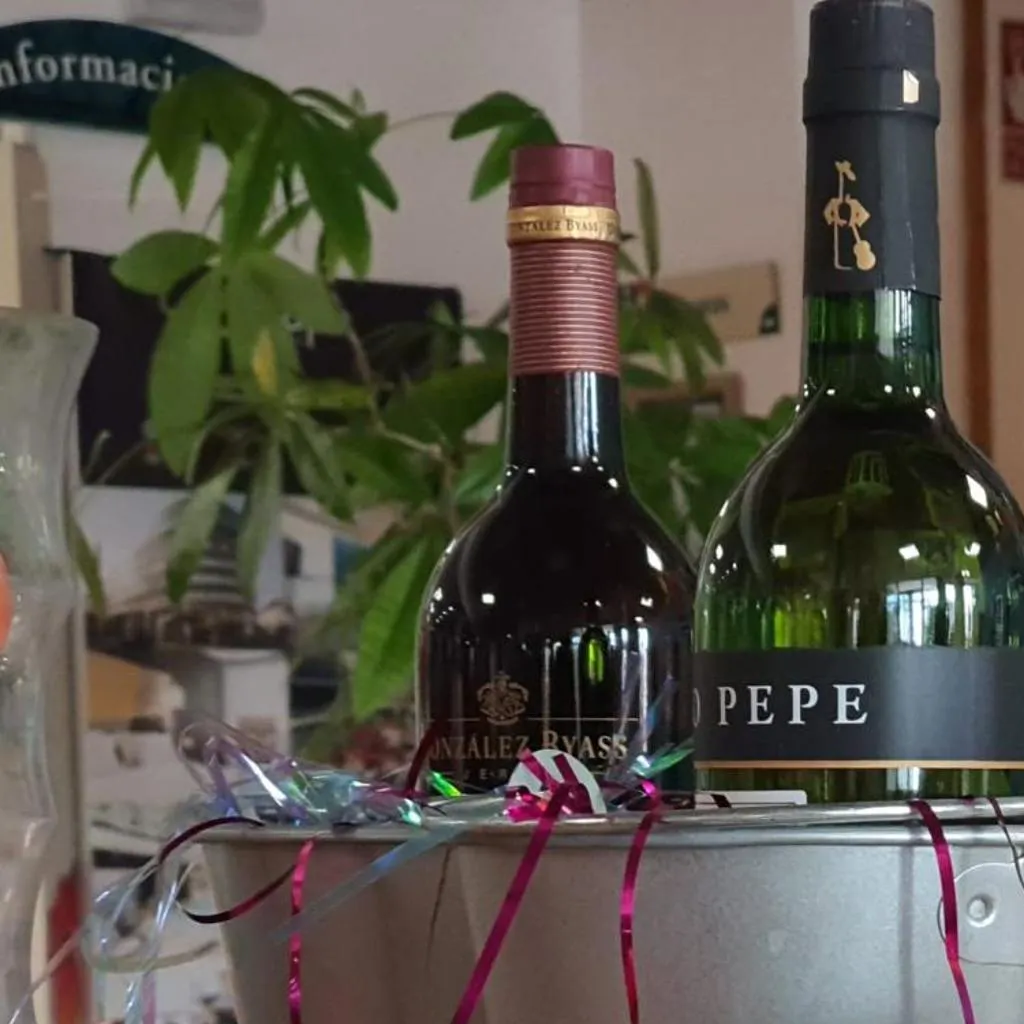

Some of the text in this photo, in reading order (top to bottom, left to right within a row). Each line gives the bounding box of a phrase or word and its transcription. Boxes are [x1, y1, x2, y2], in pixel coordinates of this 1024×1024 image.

[0, 40, 176, 92] nformaci
[718, 683, 868, 727] PEPE
[541, 729, 628, 760] BYASS
